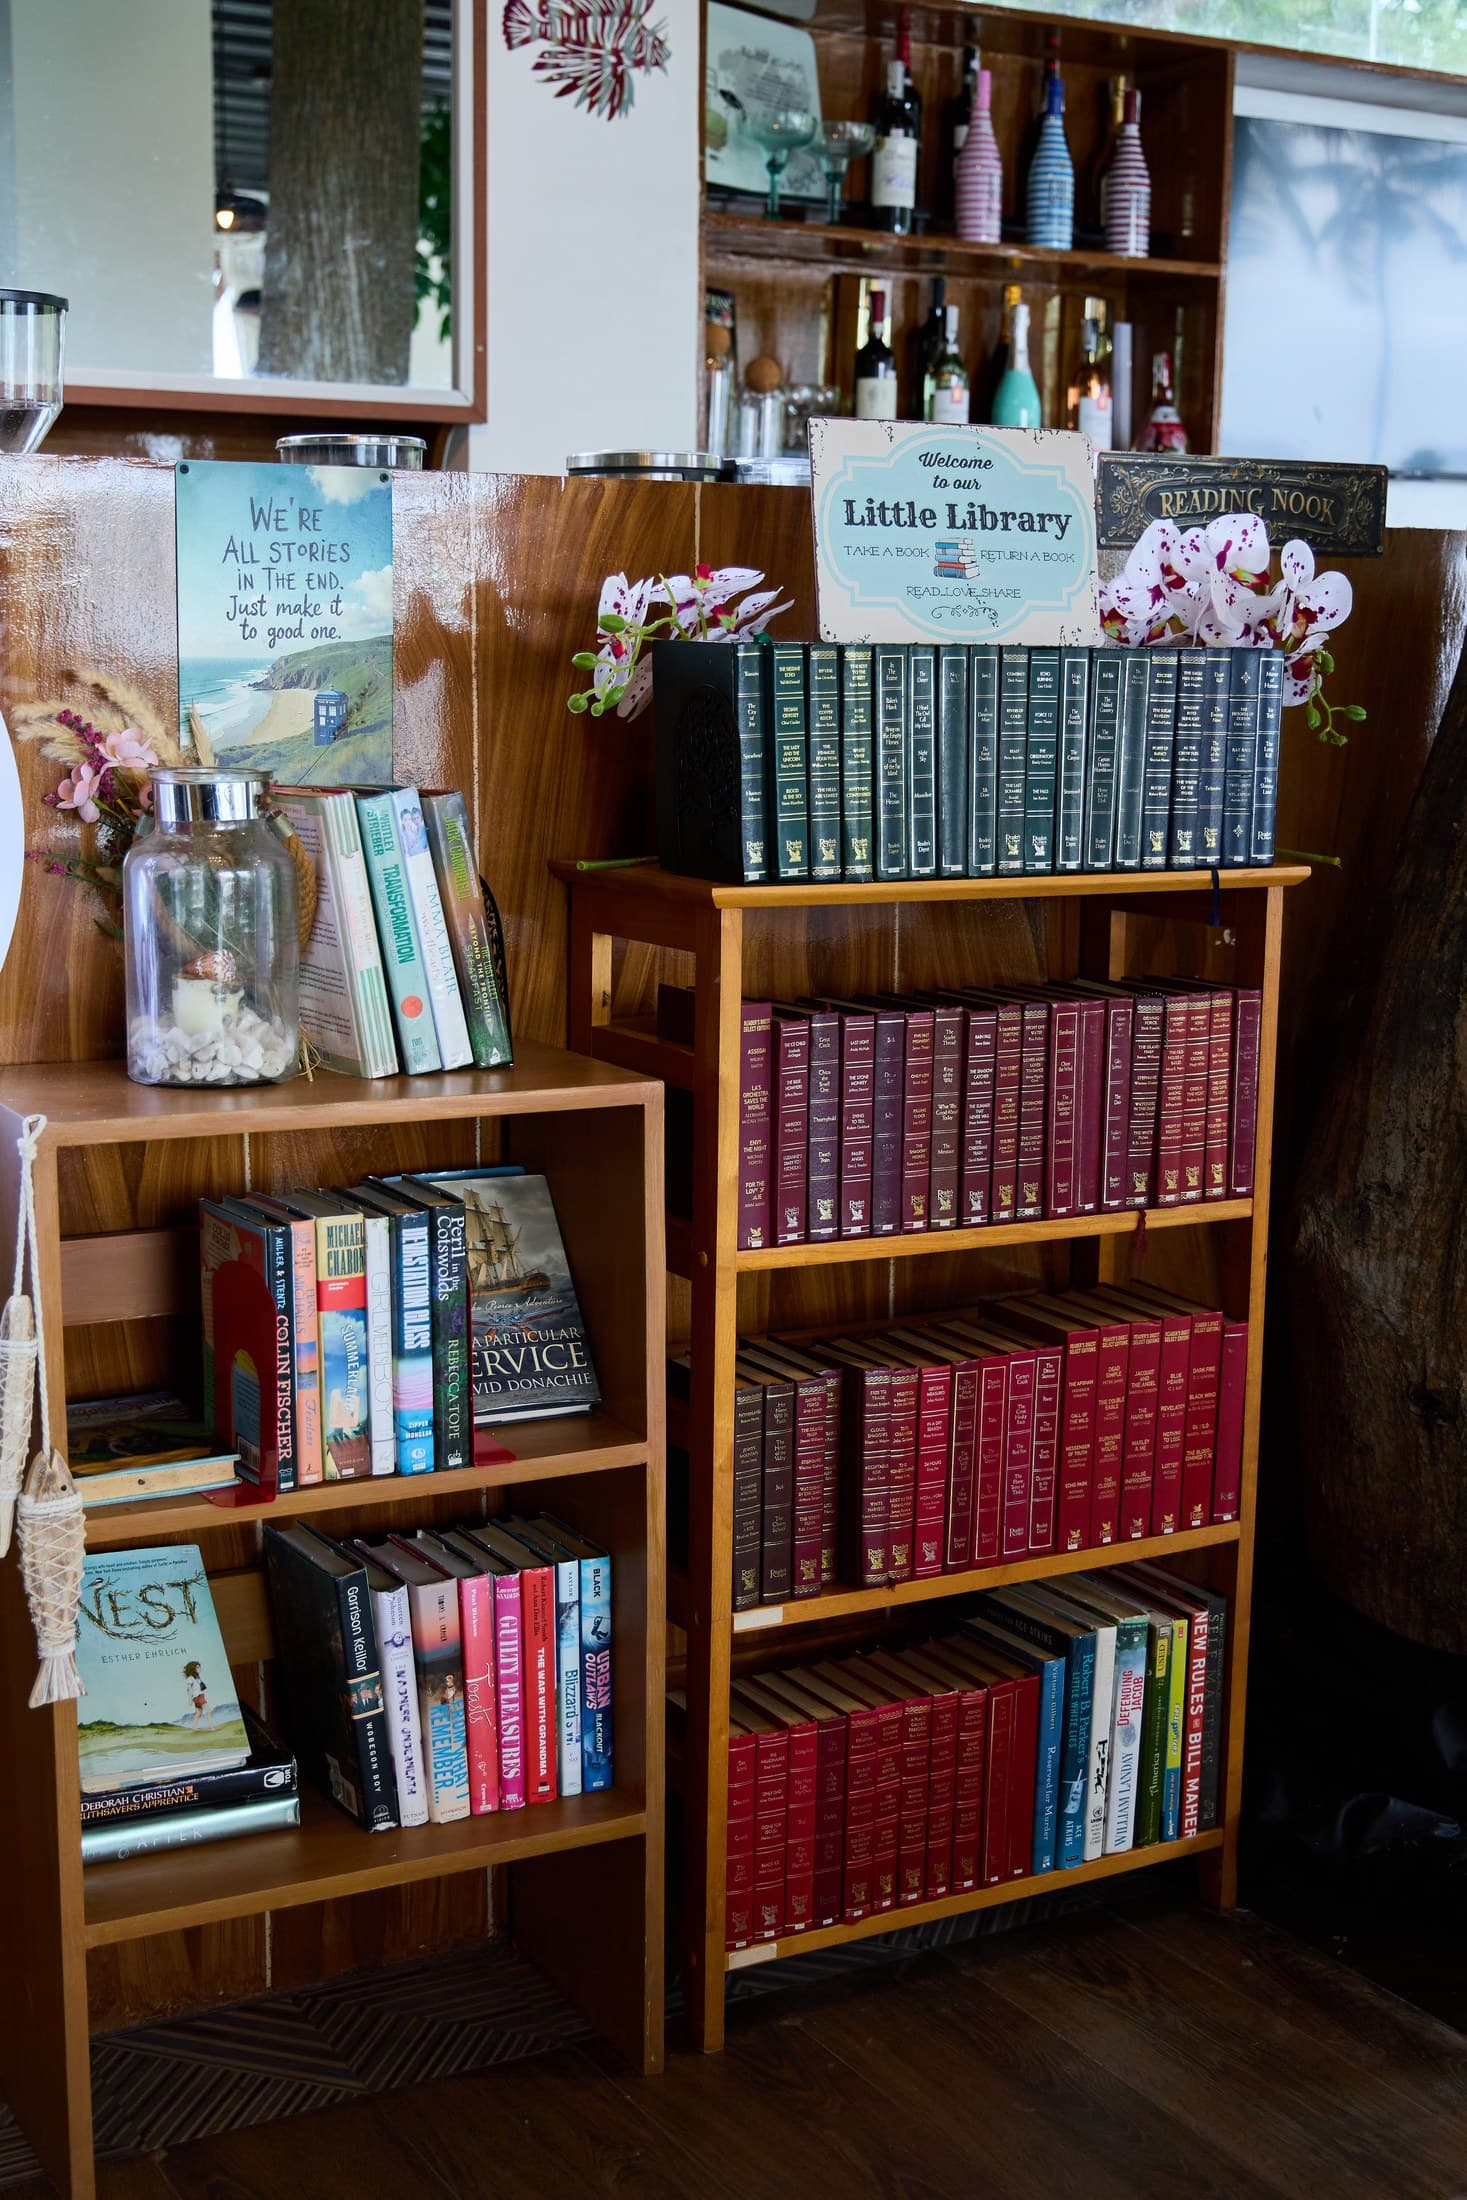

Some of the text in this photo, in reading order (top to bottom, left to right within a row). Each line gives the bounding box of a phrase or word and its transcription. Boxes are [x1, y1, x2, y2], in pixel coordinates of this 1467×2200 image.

[918, 451, 994, 470] Welcome
[933, 474, 981, 490] to our
[250, 497, 323, 532] WE'RE
[843, 498, 1072, 540] Little Library
[1159, 487, 1336, 526] READING NOOK
[222, 535, 350, 564] ALL STORIES
[843, 546, 930, 557] TAKE A BOOK
[980, 550, 1075, 562] RETURN A BOOK
[262, 567, 296, 590] THE
[306, 572, 344, 590] END.
[227, 594, 343, 621] Just make it
[239, 618, 342, 648] to good one.
[366, 808, 384, 857] STRIEBER
[444, 816, 461, 843] JACK
[449, 845, 472, 903] CAMPBELL
[382, 863, 416, 964] TRANSFORMATION
[426, 883, 445, 938] EMMA
[438, 942, 458, 995] BLAIR
[469, 925, 481, 959] BEYOND
[465, 944, 483, 1012] STEADFAST
[275, 1237, 284, 1267] MILLER
[327, 1222, 364, 1248] MICHAEL
[451, 1216, 466, 1290] Peril in the
[401, 1227, 429, 1308] DEVASTATION
[436, 1216, 449, 1301] Cotswolds
[276, 1280, 286, 1309] STENTZ
[306, 1289, 315, 1318] FERN
[472, 1327, 582, 1348] A PARTICULAR
[472, 1341, 588, 1378] ERVICE
[277, 1314, 292, 1461] COLIN FISCHER
[449, 1339, 461, 1439] REBECCA TOPE
[508, 1372, 593, 1391] DONACHIE
[593, 1568, 601, 1598] BLACK
[347, 1586, 368, 1671] Garrison Keillor
[101, 1647, 187, 1664] ESTHER EHRLICH
[1158, 1643, 1167, 1672] USED
[466, 1662, 494, 1727] Toasts
[499, 1615, 521, 1779] GUILTY PLEASURES
[585, 1652, 598, 1710] OUTLAWS
[598, 1649, 610, 1708] URBAN
[1131, 1676, 1144, 1711] JACOB
[537, 1647, 547, 1776] THE WAR WITH GRANDMA
[1068, 1672, 1081, 1749] LITTLE WHITE LIES
[1078, 1653, 1094, 1764] Robert B. Parker's
[1117, 1670, 1133, 1727] DEFENDING
[451, 1699, 468, 1744] FROM
[595, 1713, 603, 1753] BLACKOUT
[1184, 1611, 1208, 1838] NEW RULES BILL MAHER
[366, 1721, 382, 1792] WOBEGON BOY
[430, 1704, 454, 1804] REMEMBER...
[453, 1745, 470, 1790] WHAT
[1048, 1745, 1057, 1782] Reserved
[1151, 1752, 1160, 1797] America
[81, 1786, 186, 1812] DEBORAH CHRISTIAN
[143, 1792, 199, 1809] APPRENTICE
[1114, 1752, 1134, 1847] WILLIAM LANDAY
[1044, 1804, 1053, 1841] Murder
[1065, 1820, 1074, 1847] ATKINS
